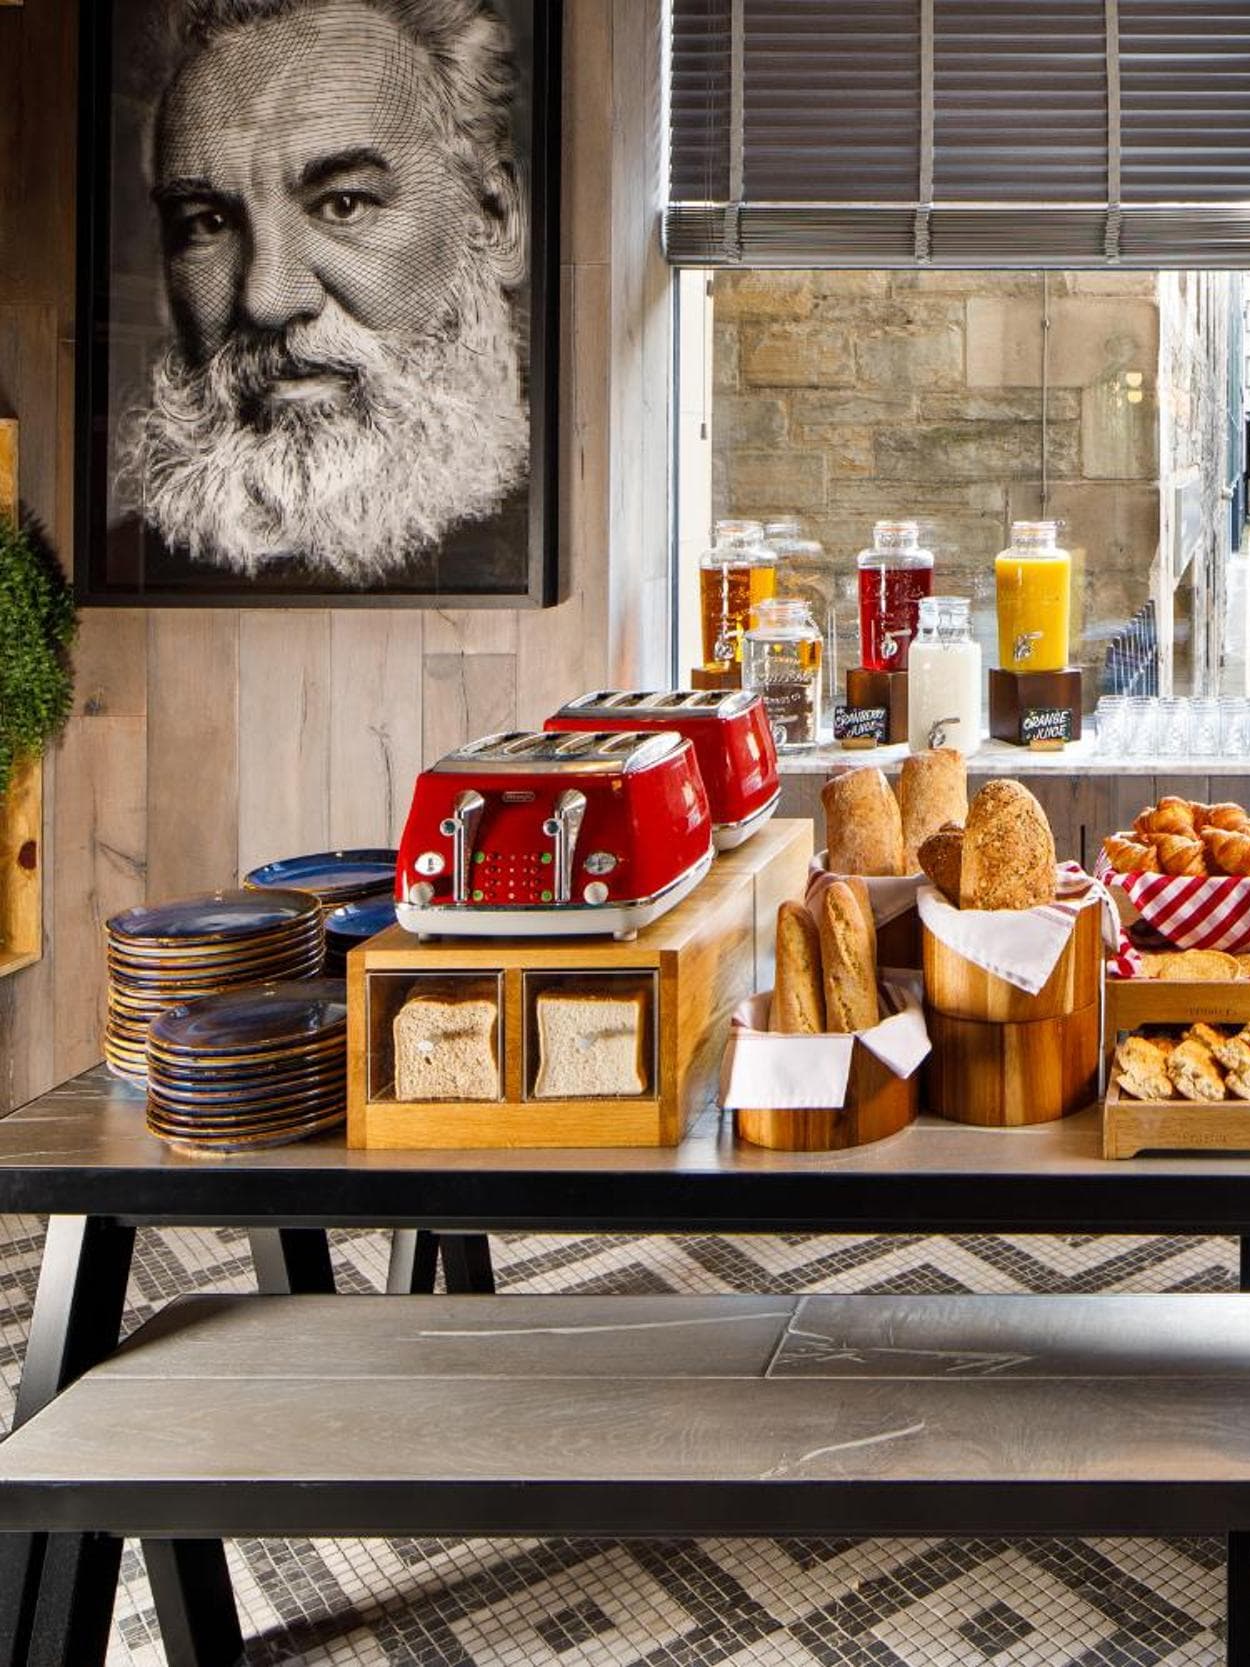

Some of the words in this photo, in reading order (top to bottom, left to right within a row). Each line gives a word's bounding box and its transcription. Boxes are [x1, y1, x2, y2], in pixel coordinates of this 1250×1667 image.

[835, 709, 886, 727] CRANBERRY
[1023, 711, 1069, 730] ORANGE
[846, 721, 876, 738] JUICE
[1033, 724, 1067, 740] JUICE
